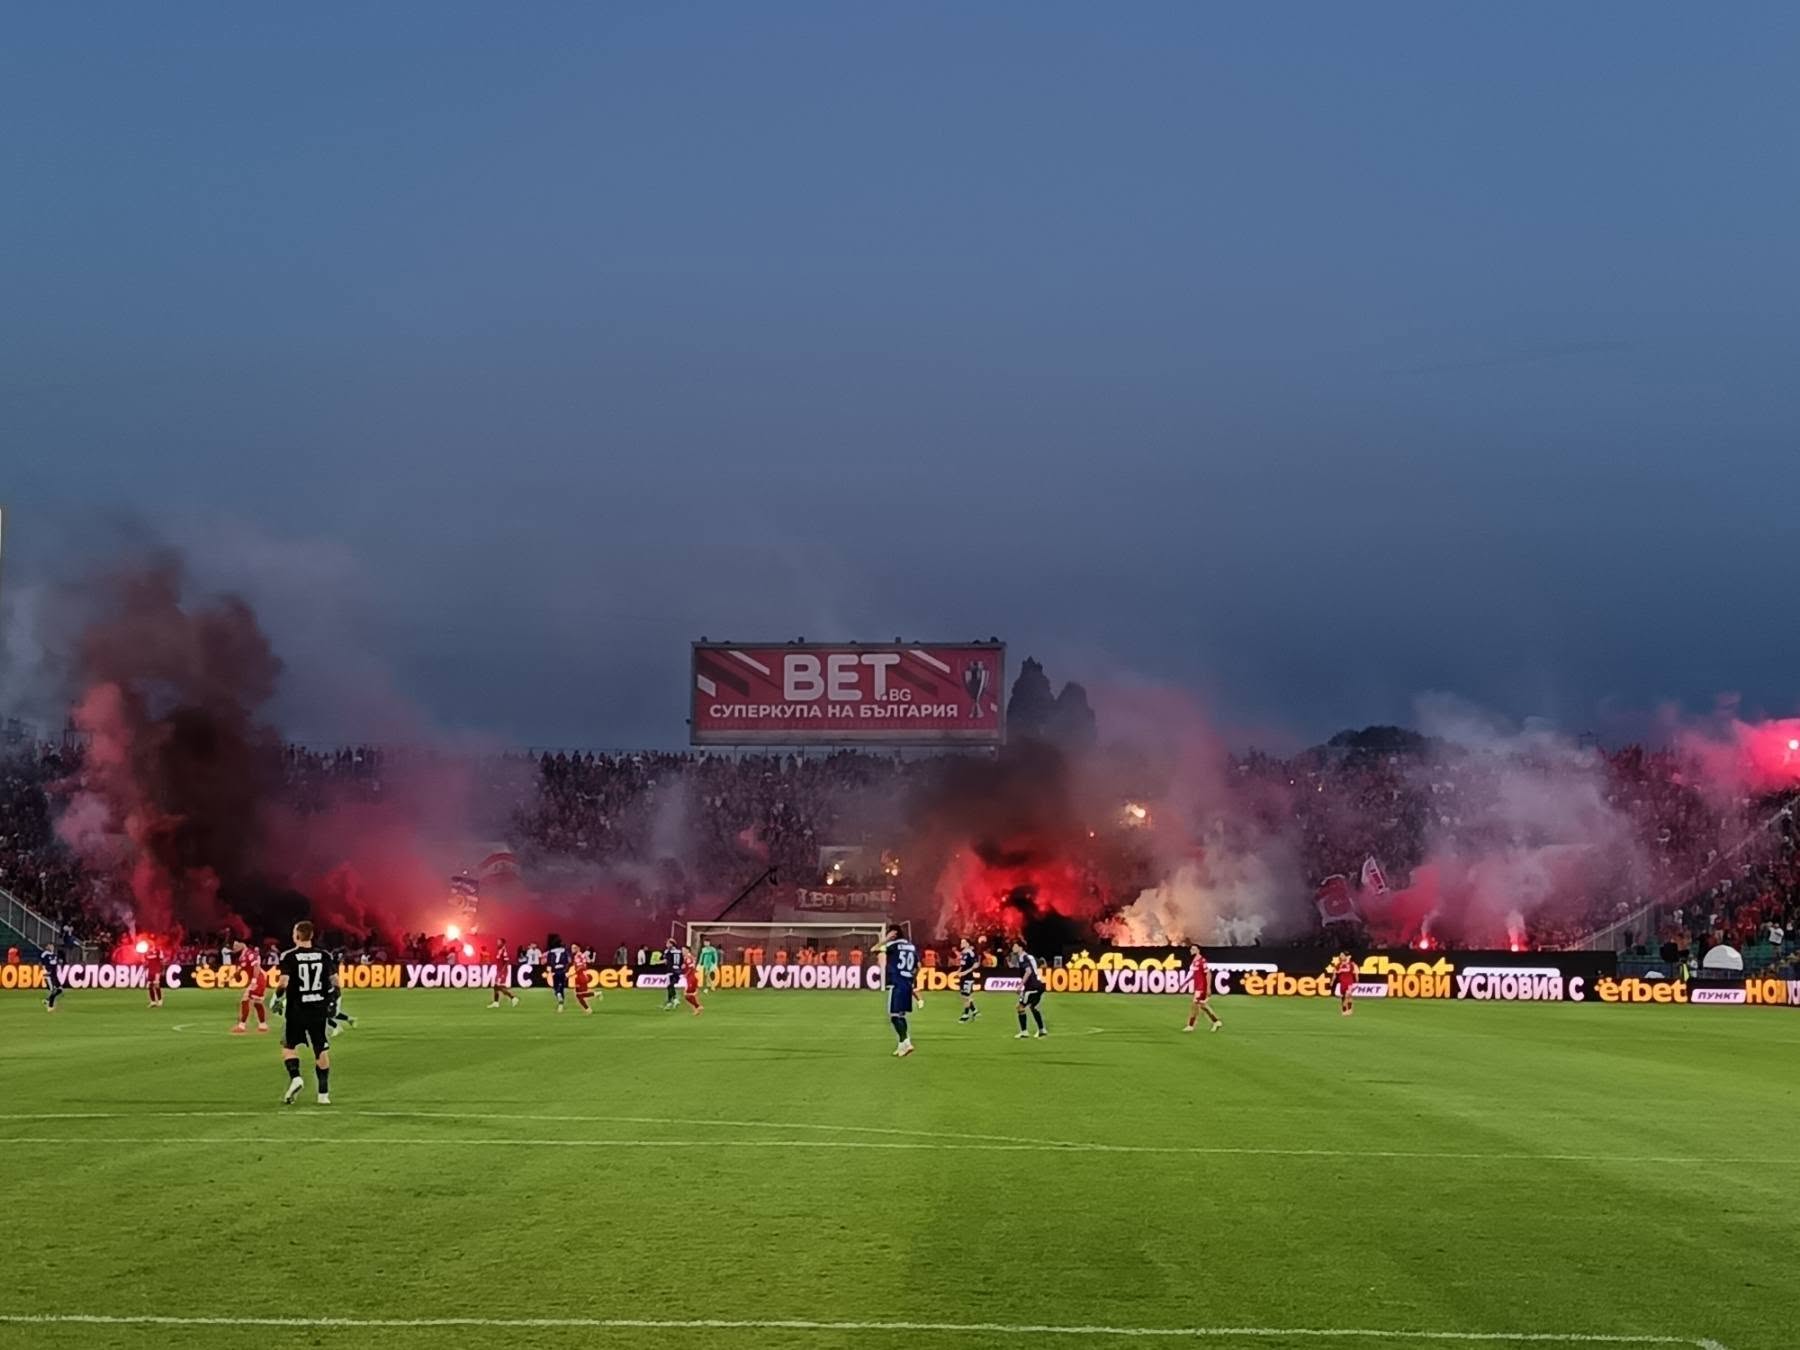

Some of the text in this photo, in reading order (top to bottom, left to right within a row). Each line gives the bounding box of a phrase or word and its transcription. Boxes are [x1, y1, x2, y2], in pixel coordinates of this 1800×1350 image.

[709, 703, 959, 719] СУПЕРКУПА НА БЪЛГАРИЯ
[897, 951, 915, 971] 50
[166, 964, 182, 988] С
[298, 962, 323, 991] 92
[338, 964, 401, 988] НОВИ
[517, 964, 533, 988] С
[756, 964, 861, 989] УСЛОВИЯ
[866, 965, 881, 989] С
[1214, 971, 1231, 995] С
[1241, 971, 1332, 996] efbet
[1388, 975, 1739, 1003] НОВИ УСЛОВИЯ С efbet ПУНКТ
